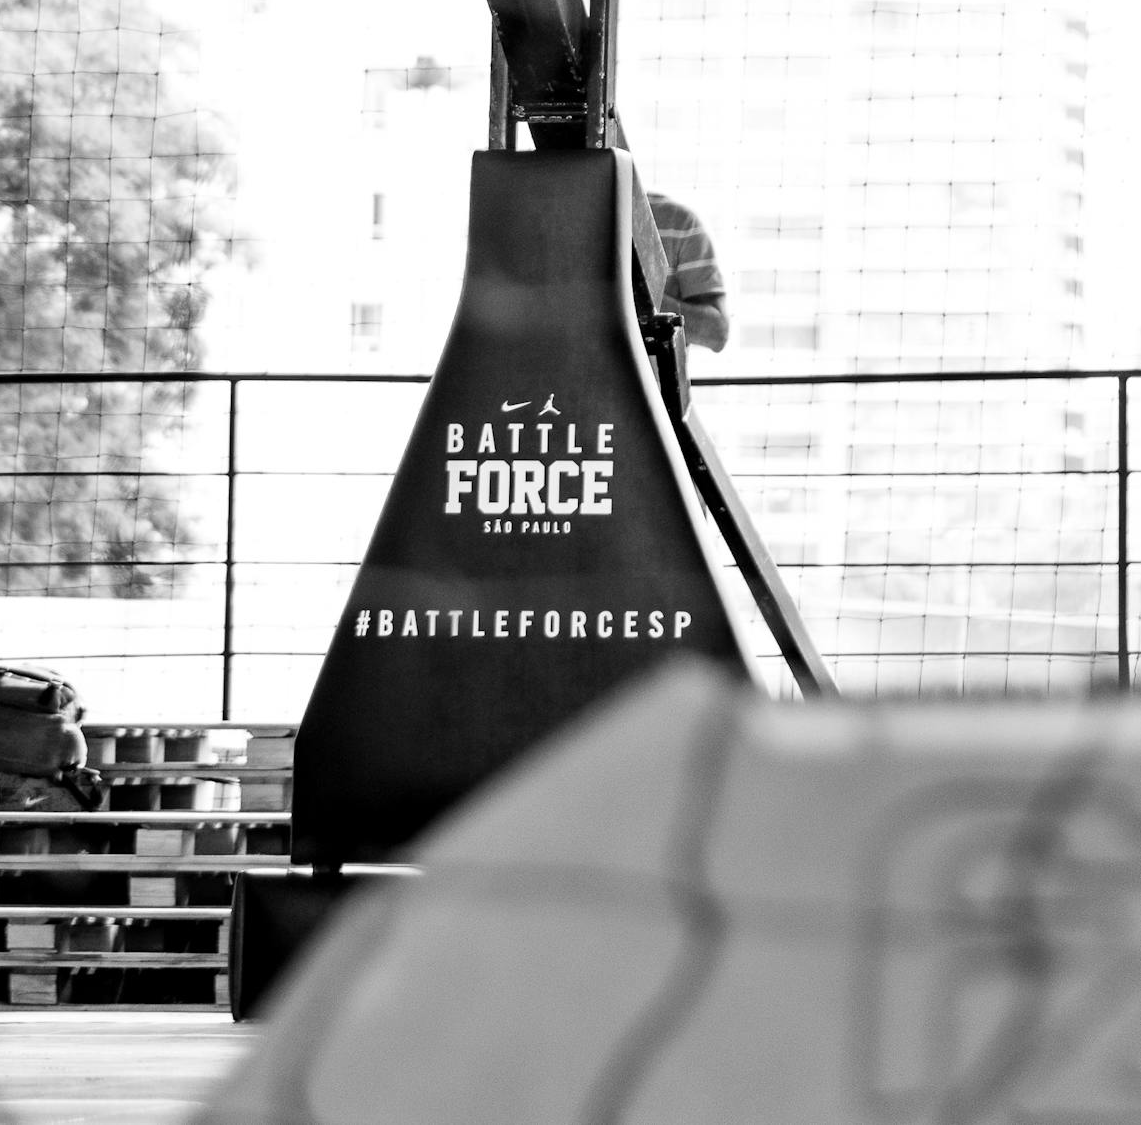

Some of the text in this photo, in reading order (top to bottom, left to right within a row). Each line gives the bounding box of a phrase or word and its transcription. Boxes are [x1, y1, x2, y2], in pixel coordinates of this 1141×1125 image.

[446, 422, 615, 455] BATTLE
[444, 459, 614, 516] FORCE
[482, 518, 571, 535] SÃO PAULO
[355, 609, 693, 639] #BATTLEFORCESP
